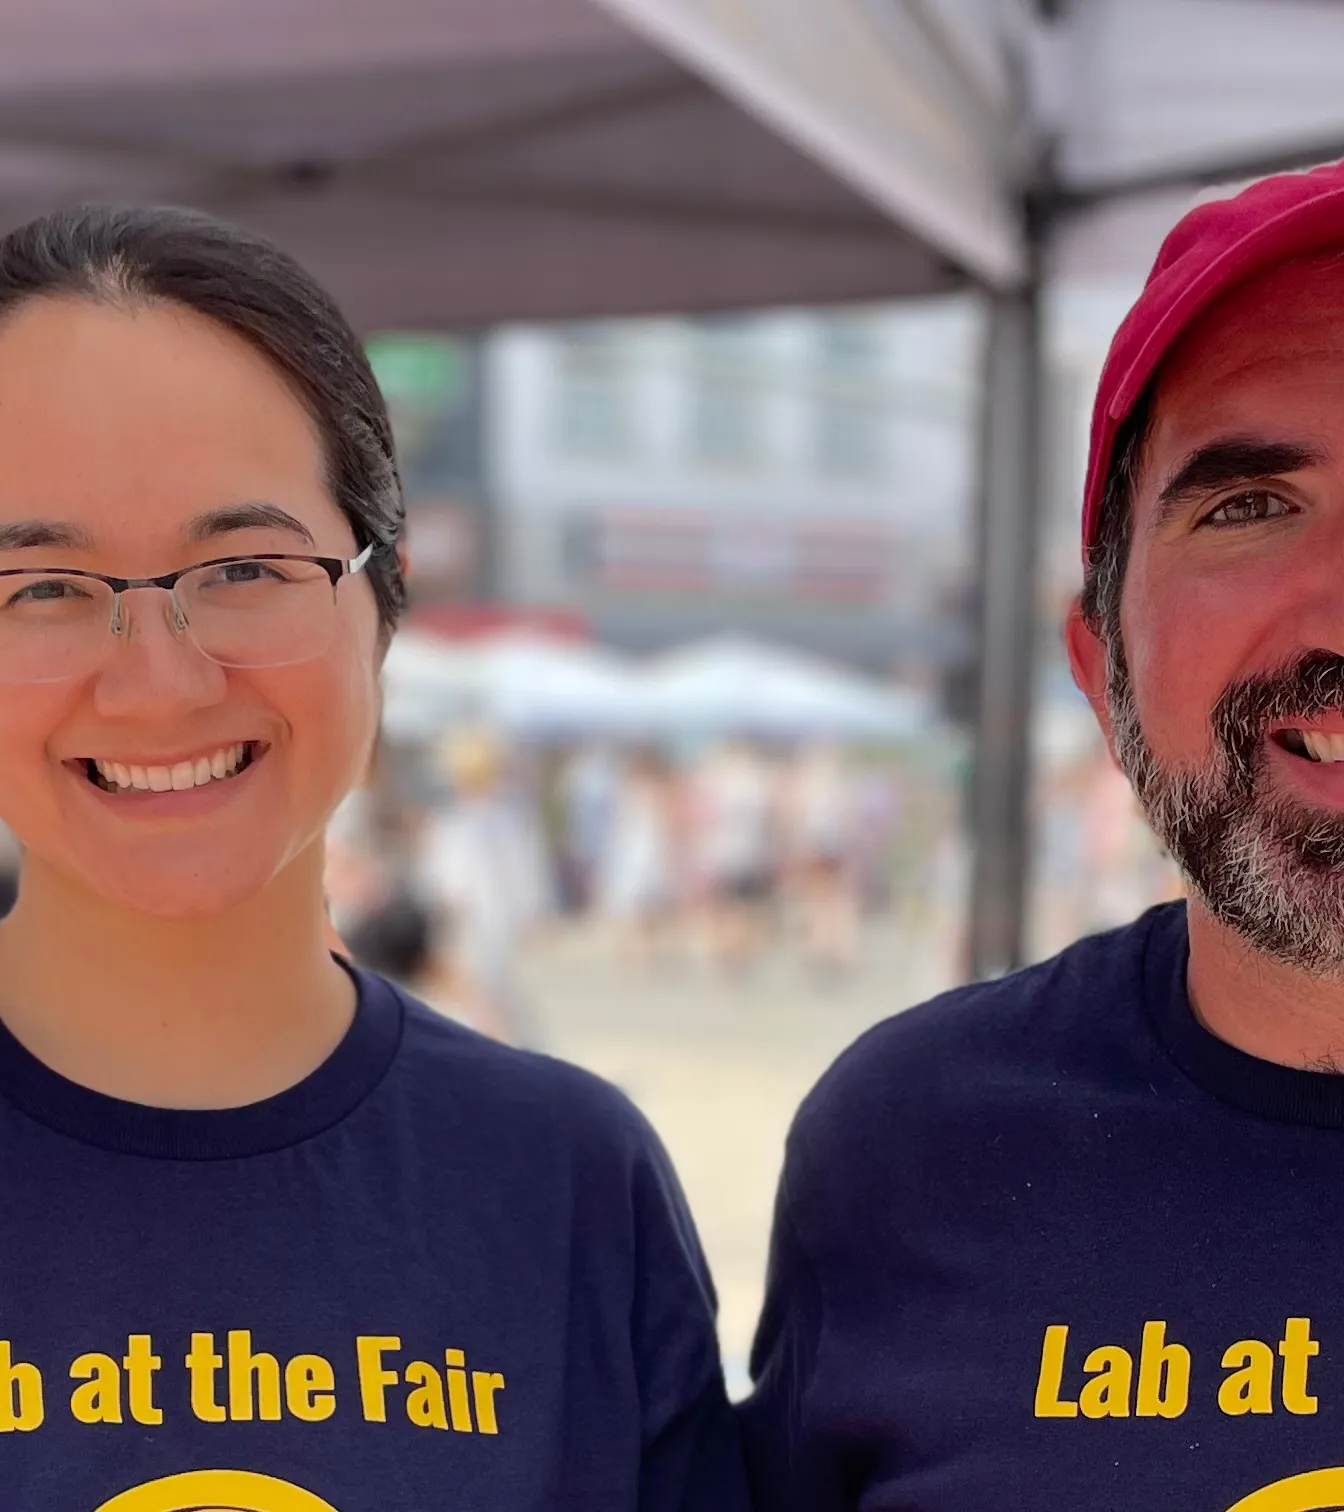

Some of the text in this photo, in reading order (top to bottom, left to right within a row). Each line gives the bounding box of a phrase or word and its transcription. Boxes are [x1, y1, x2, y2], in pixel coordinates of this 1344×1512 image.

[69, 1334, 163, 1425] at
[185, 1329, 336, 1423] the
[356, 1335, 505, 1435] Fair
[1034, 1320, 1191, 1419] Lab
[1217, 1317, 1320, 1416] at
